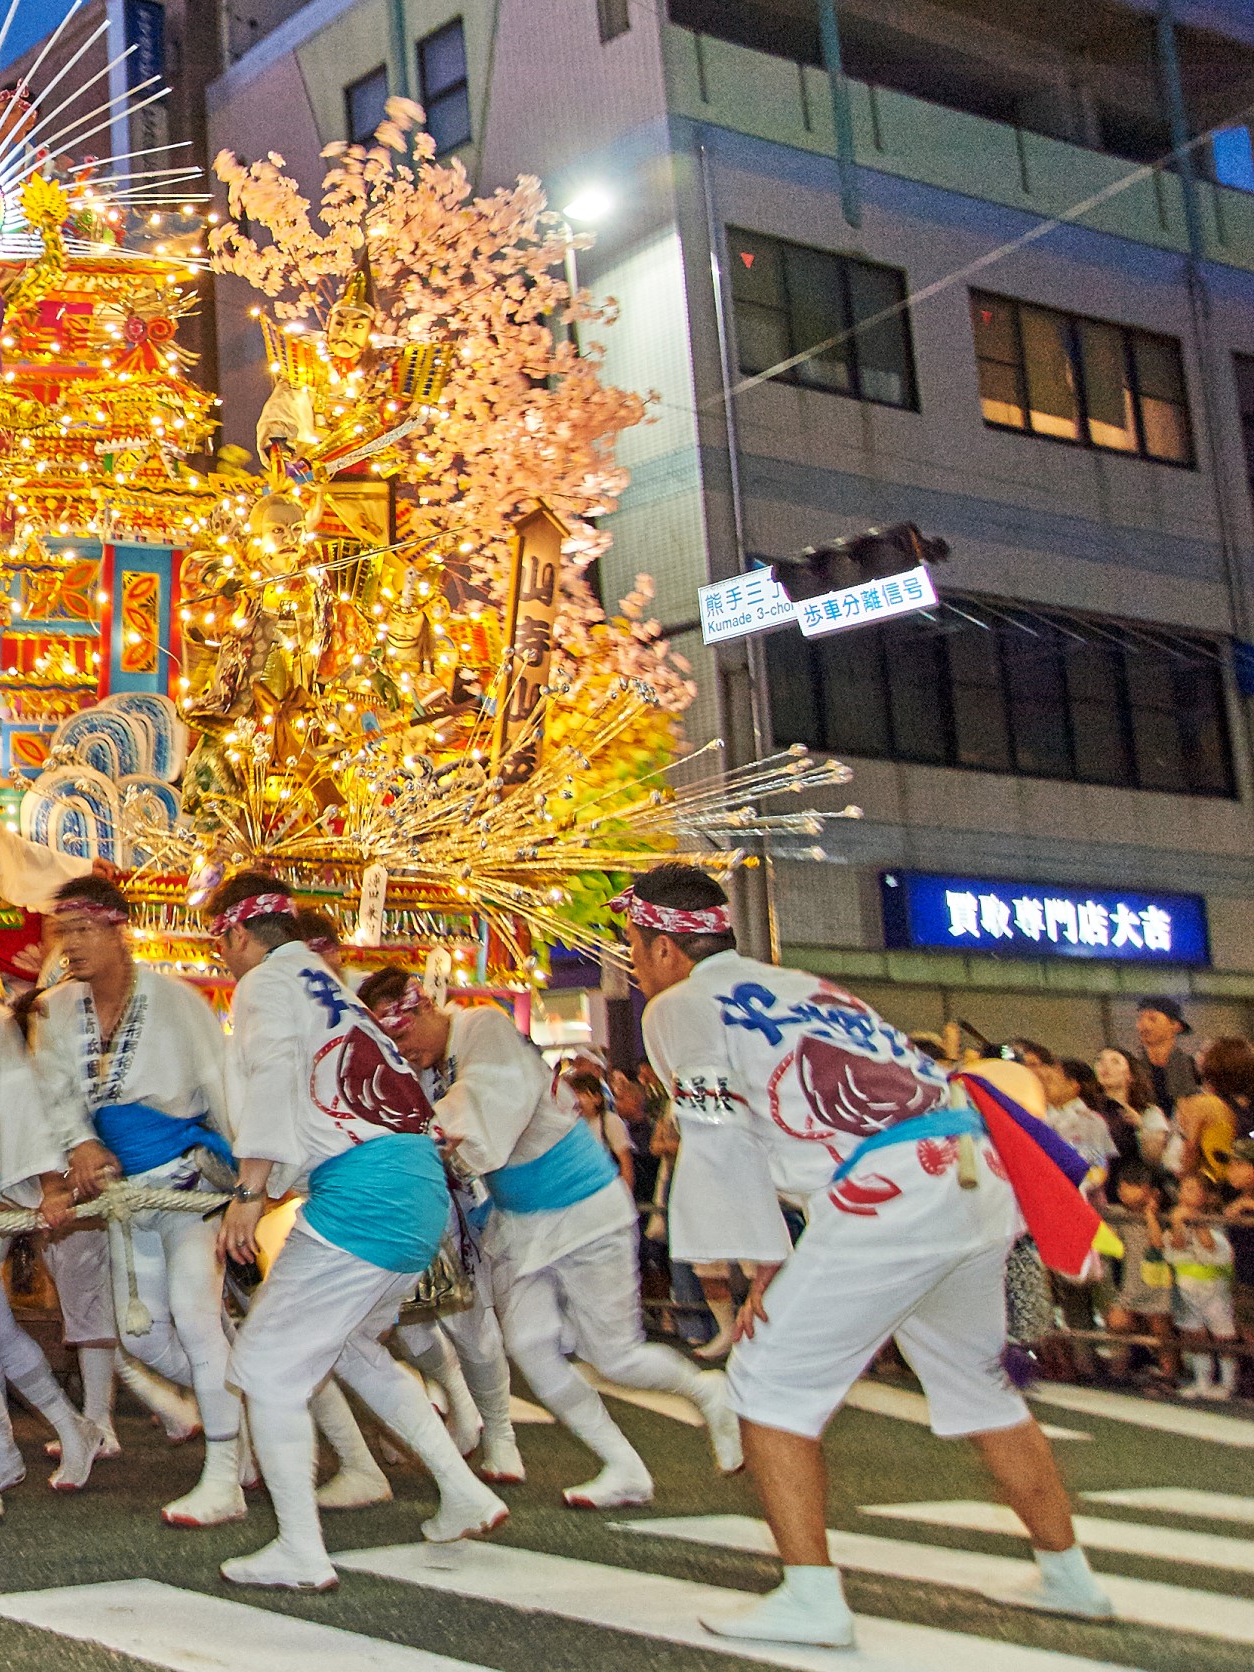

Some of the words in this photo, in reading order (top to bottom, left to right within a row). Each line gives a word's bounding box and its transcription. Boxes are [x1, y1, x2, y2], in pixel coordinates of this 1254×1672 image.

[707, 612, 753, 634] Kumade
[756, 601, 795, 620] 3-cho
[803, 577, 923, 627] 歩車分離信号
[945, 889, 1172, 951] 買取専門店大吉
